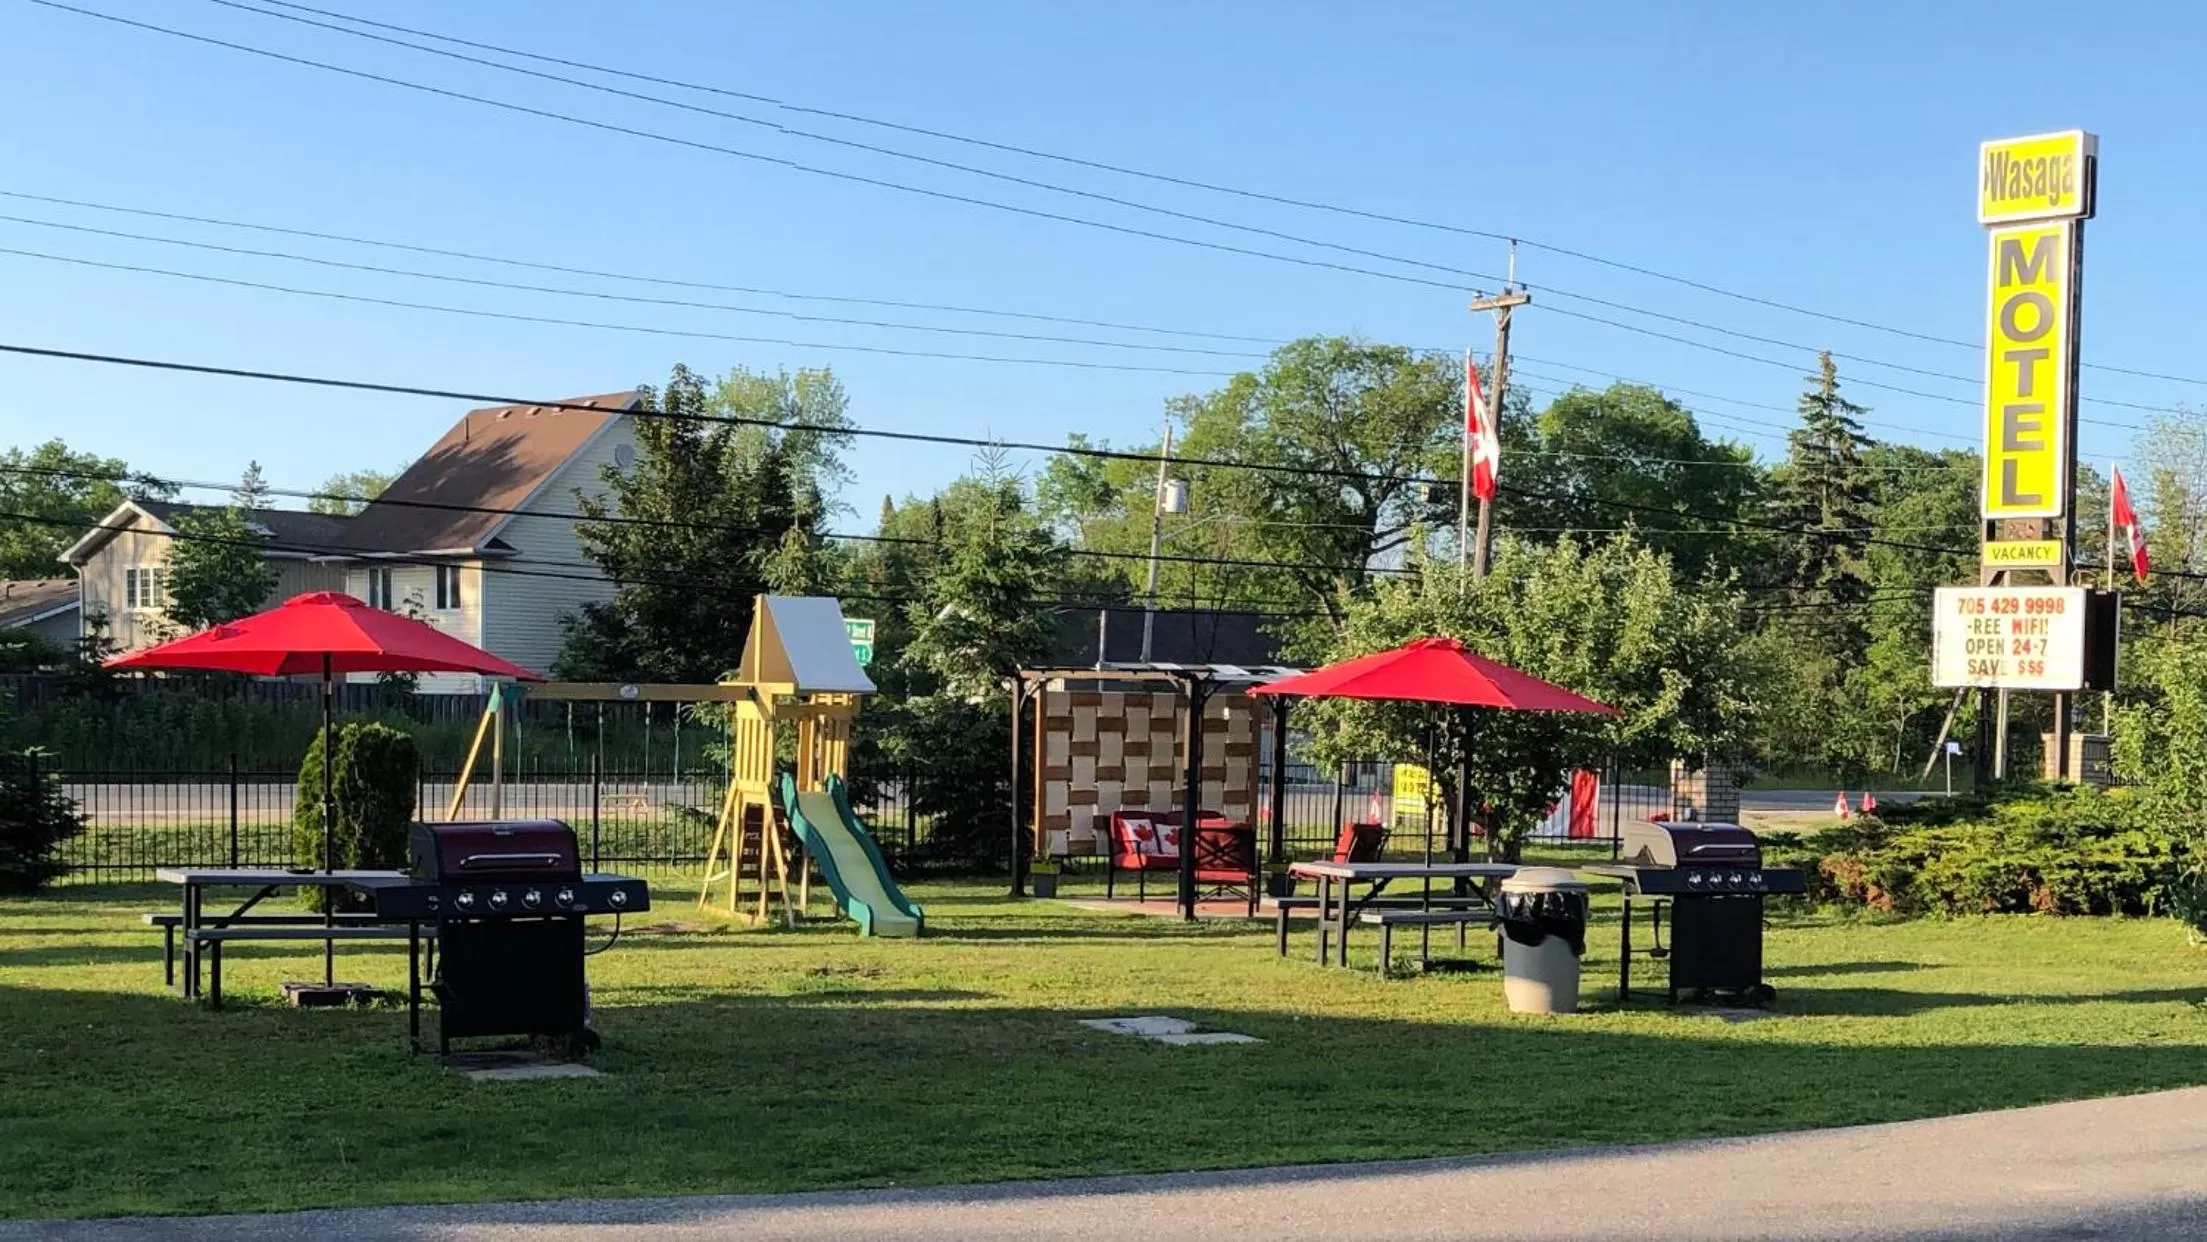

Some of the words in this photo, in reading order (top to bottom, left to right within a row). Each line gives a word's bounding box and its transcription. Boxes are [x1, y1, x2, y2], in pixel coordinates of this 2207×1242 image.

[1990, 150, 2073, 206] Wasaga
[1999, 235, 2060, 506] MOTEL
[1992, 546, 2052, 561] VACANCY
[1958, 598, 1985, 614] 705
[1991, 598, 2019, 614] 429
[2025, 598, 2064, 614] 9998
[1967, 619, 2001, 635] REE
[1965, 638, 2005, 655] OPEN
[2012, 638, 2048, 655] 24-7
